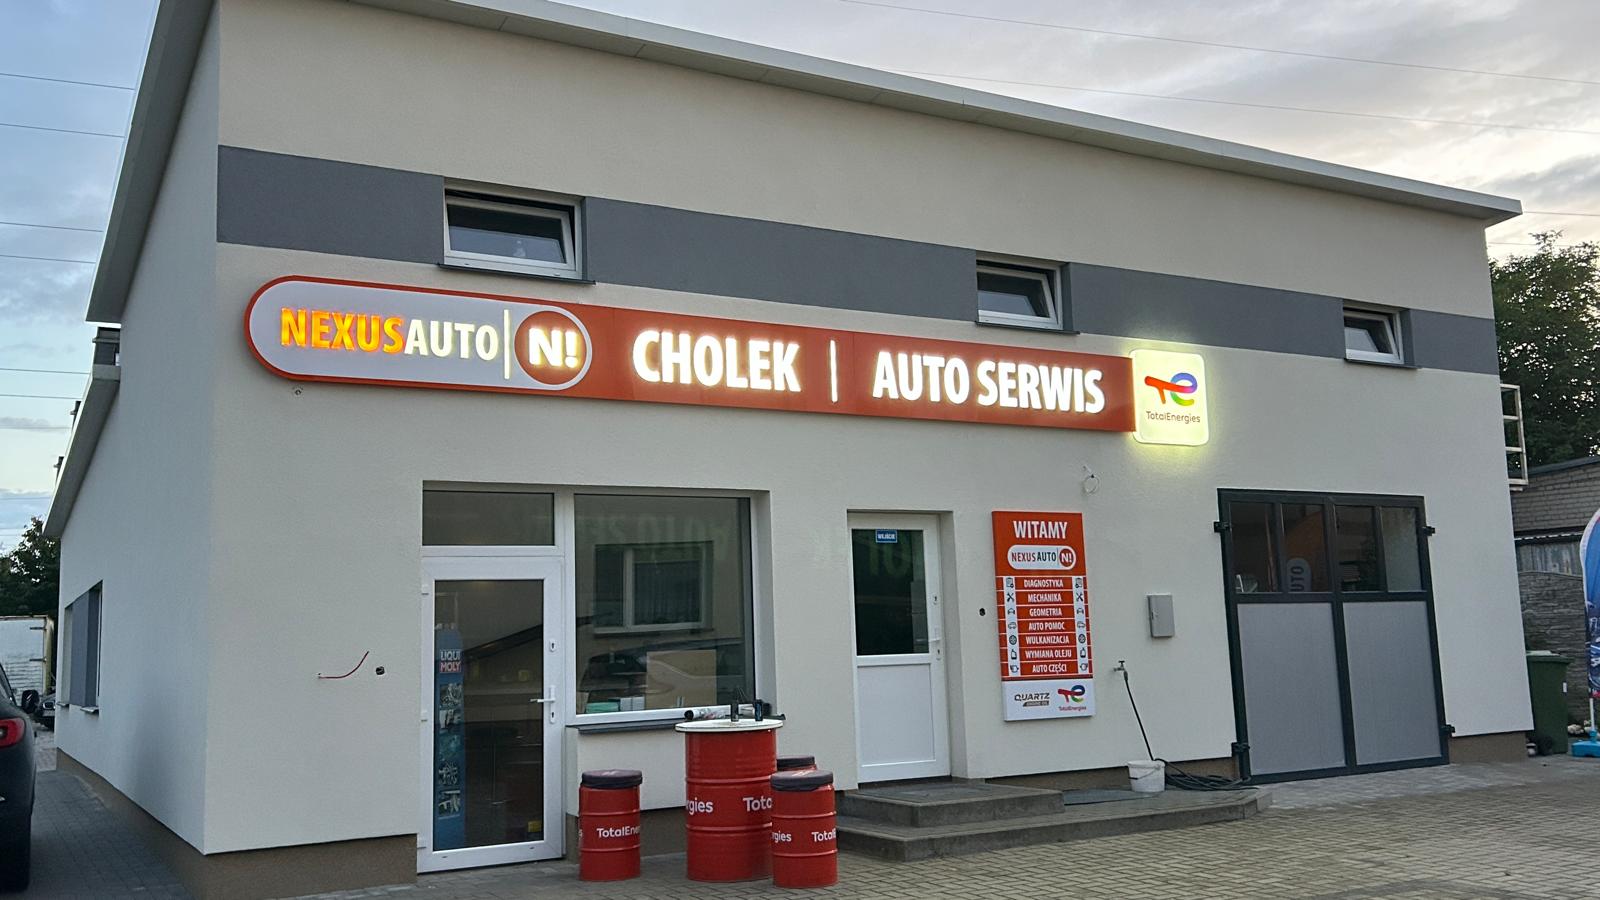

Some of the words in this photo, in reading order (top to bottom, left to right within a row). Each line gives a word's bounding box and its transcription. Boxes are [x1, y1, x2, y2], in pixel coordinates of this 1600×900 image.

[528, 327, 579, 368] N!
[633, 329, 802, 393] CHOLEK
[872, 351, 971, 405] AUTO
[977, 361, 1106, 414] SERWIS
[1146, 411, 1201, 425] TotalEnergies
[1013, 520, 1068, 539] WITAMY
[1023, 579, 1064, 588] DIAGNOSTYKA
[1027, 593, 1062, 603] MECHANIKA
[1029, 608, 1062, 617] GEOMETRIA
[1028, 622, 1044, 631] AUTO
[1044, 621, 1066, 631] POMOC
[1025, 635, 1070, 645] WULKANIZACJA
[440, 651, 461, 661] LIQUI
[1025, 650, 1054, 659] WYMIANA
[1054, 649, 1072, 658] OLEJU
[440, 661, 461, 672] MOLY
[1032, 664, 1047, 673] AUTO
[1014, 692, 1050, 702] QUARTZ
